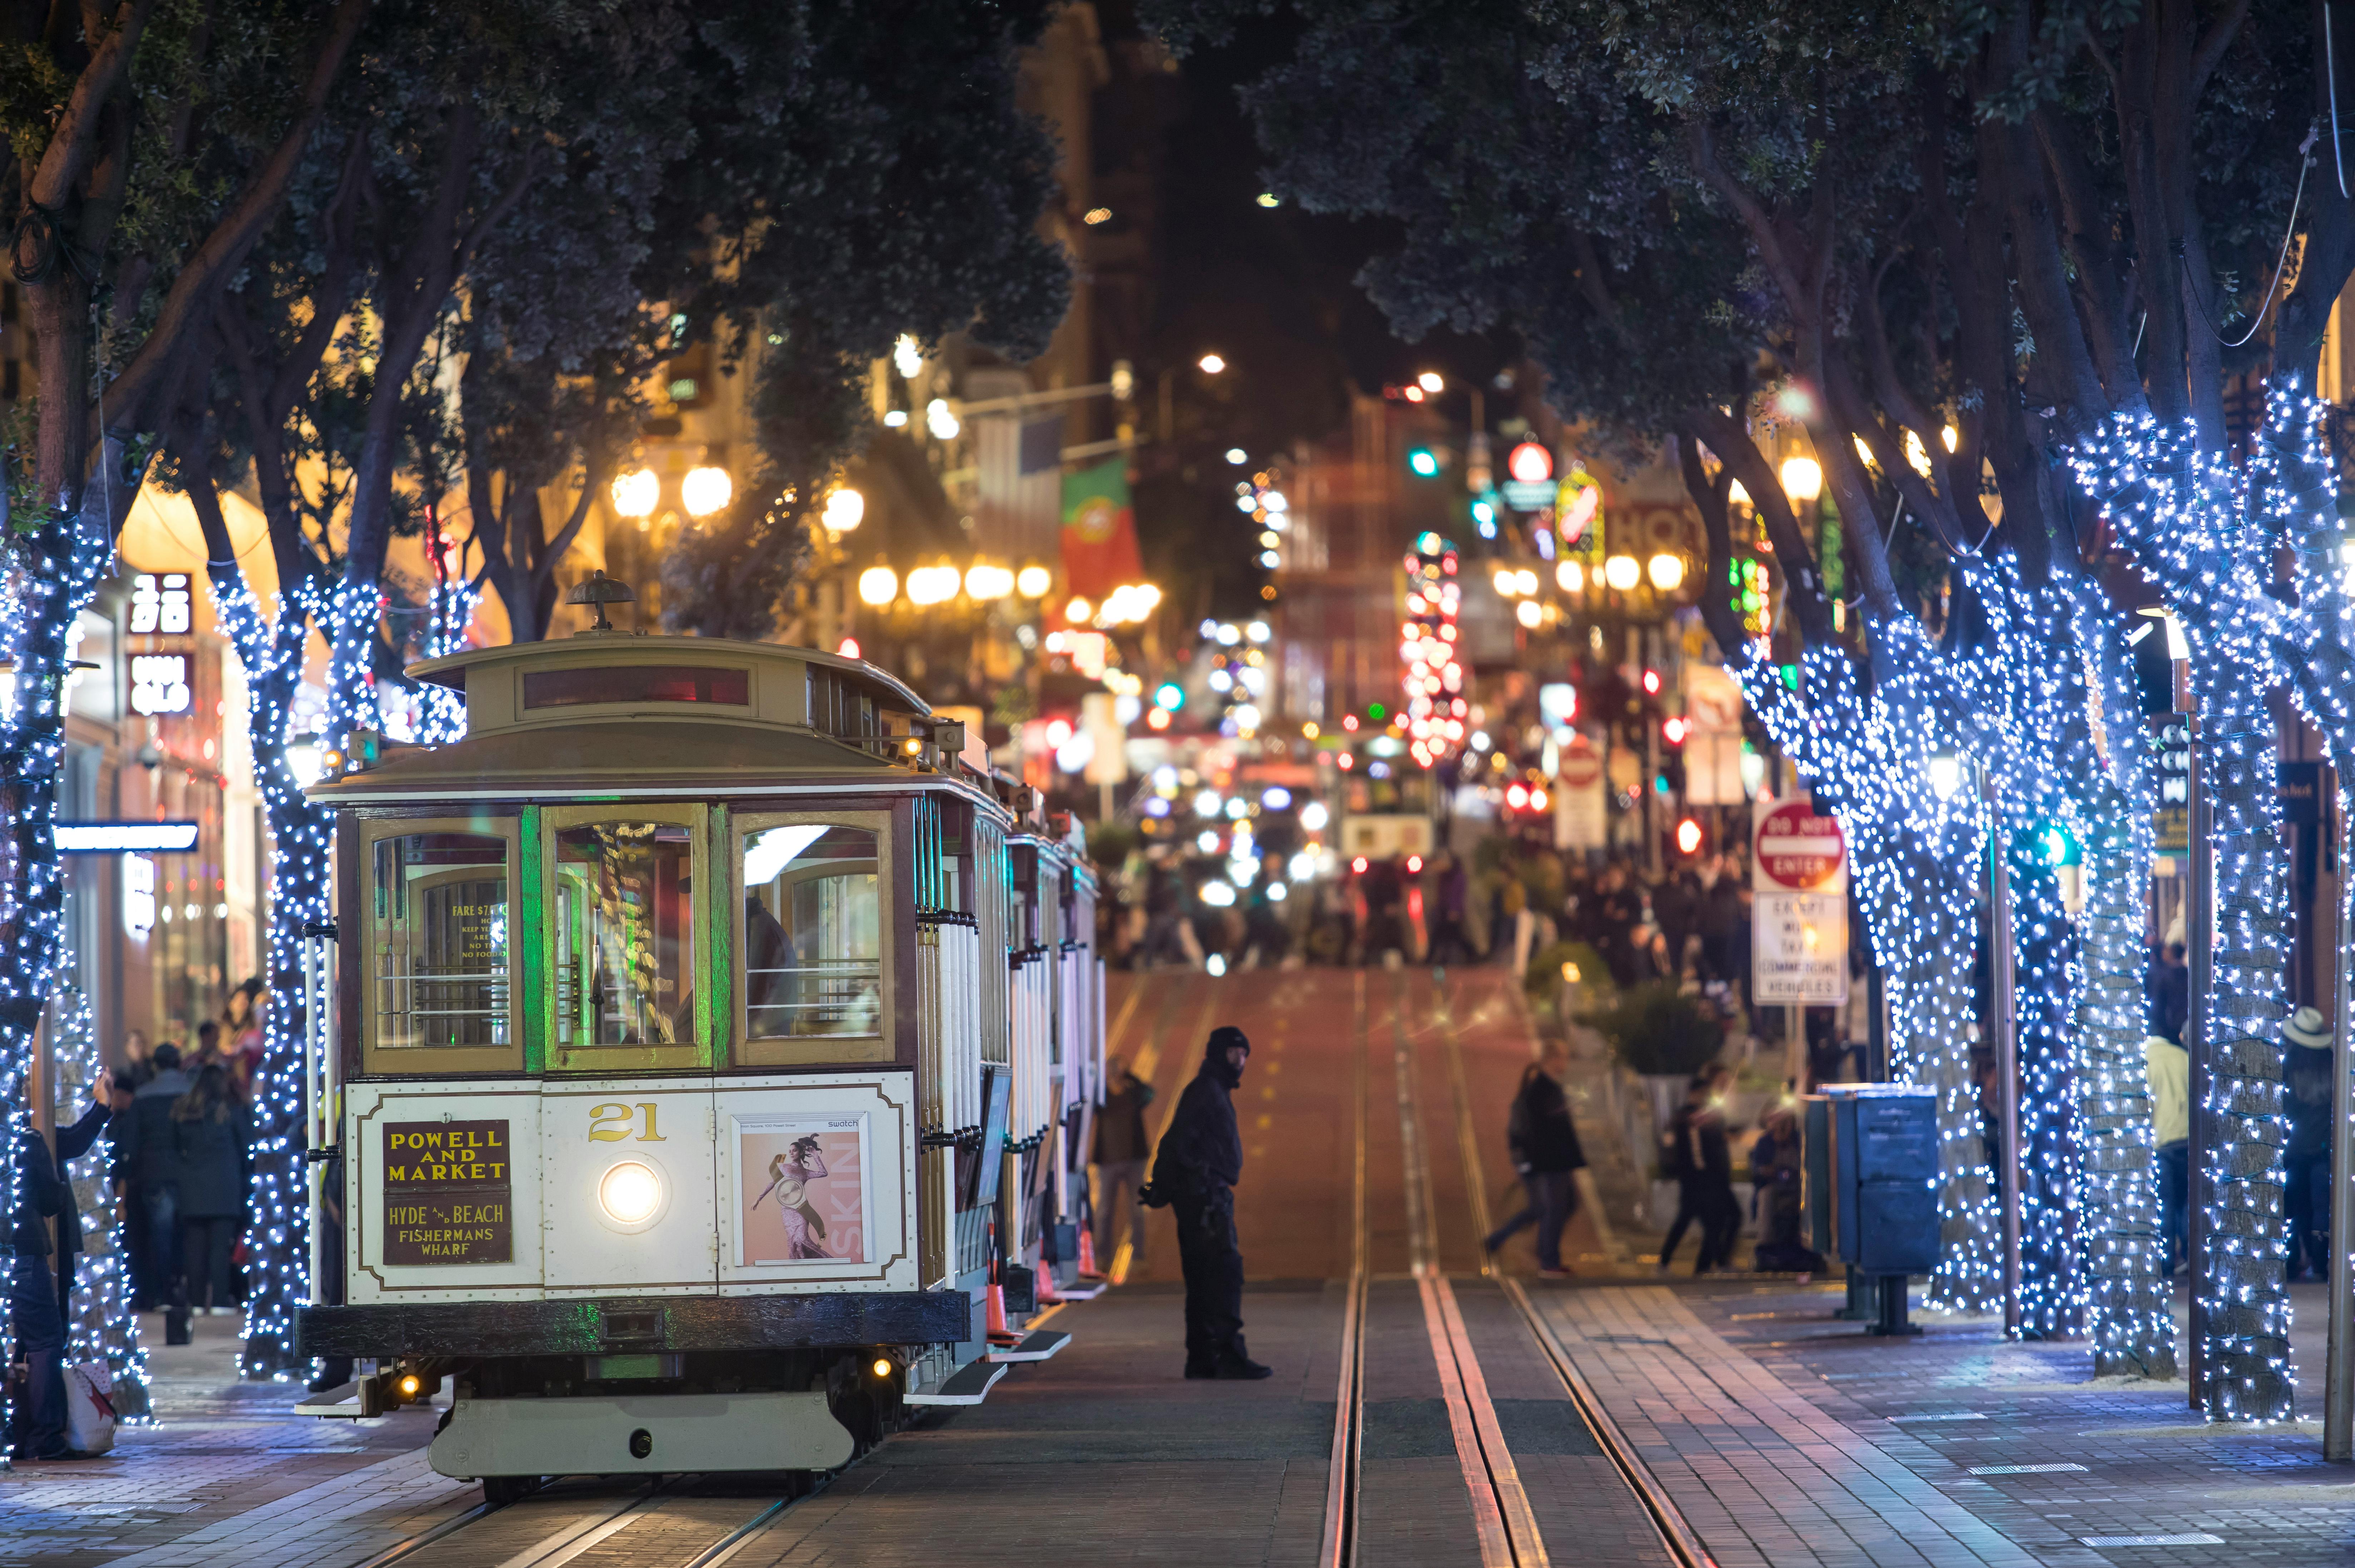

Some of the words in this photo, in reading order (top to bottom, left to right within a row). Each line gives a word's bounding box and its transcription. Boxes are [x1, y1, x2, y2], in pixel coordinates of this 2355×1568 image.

[452, 905, 475, 916] FARE
[589, 1103, 667, 1142] 21
[390, 1131, 502, 1149] POWELL
[420, 1150, 476, 1162] AND
[389, 1163, 505, 1181] MARKET
[830, 1143, 862, 1255] SKIN
[390, 1207, 427, 1225] HYDE
[432, 1207, 450, 1224] AND
[453, 1205, 503, 1224] BEACH
[399, 1228, 494, 1242] FISHERMANS
[422, 1243, 470, 1255] WHARF
